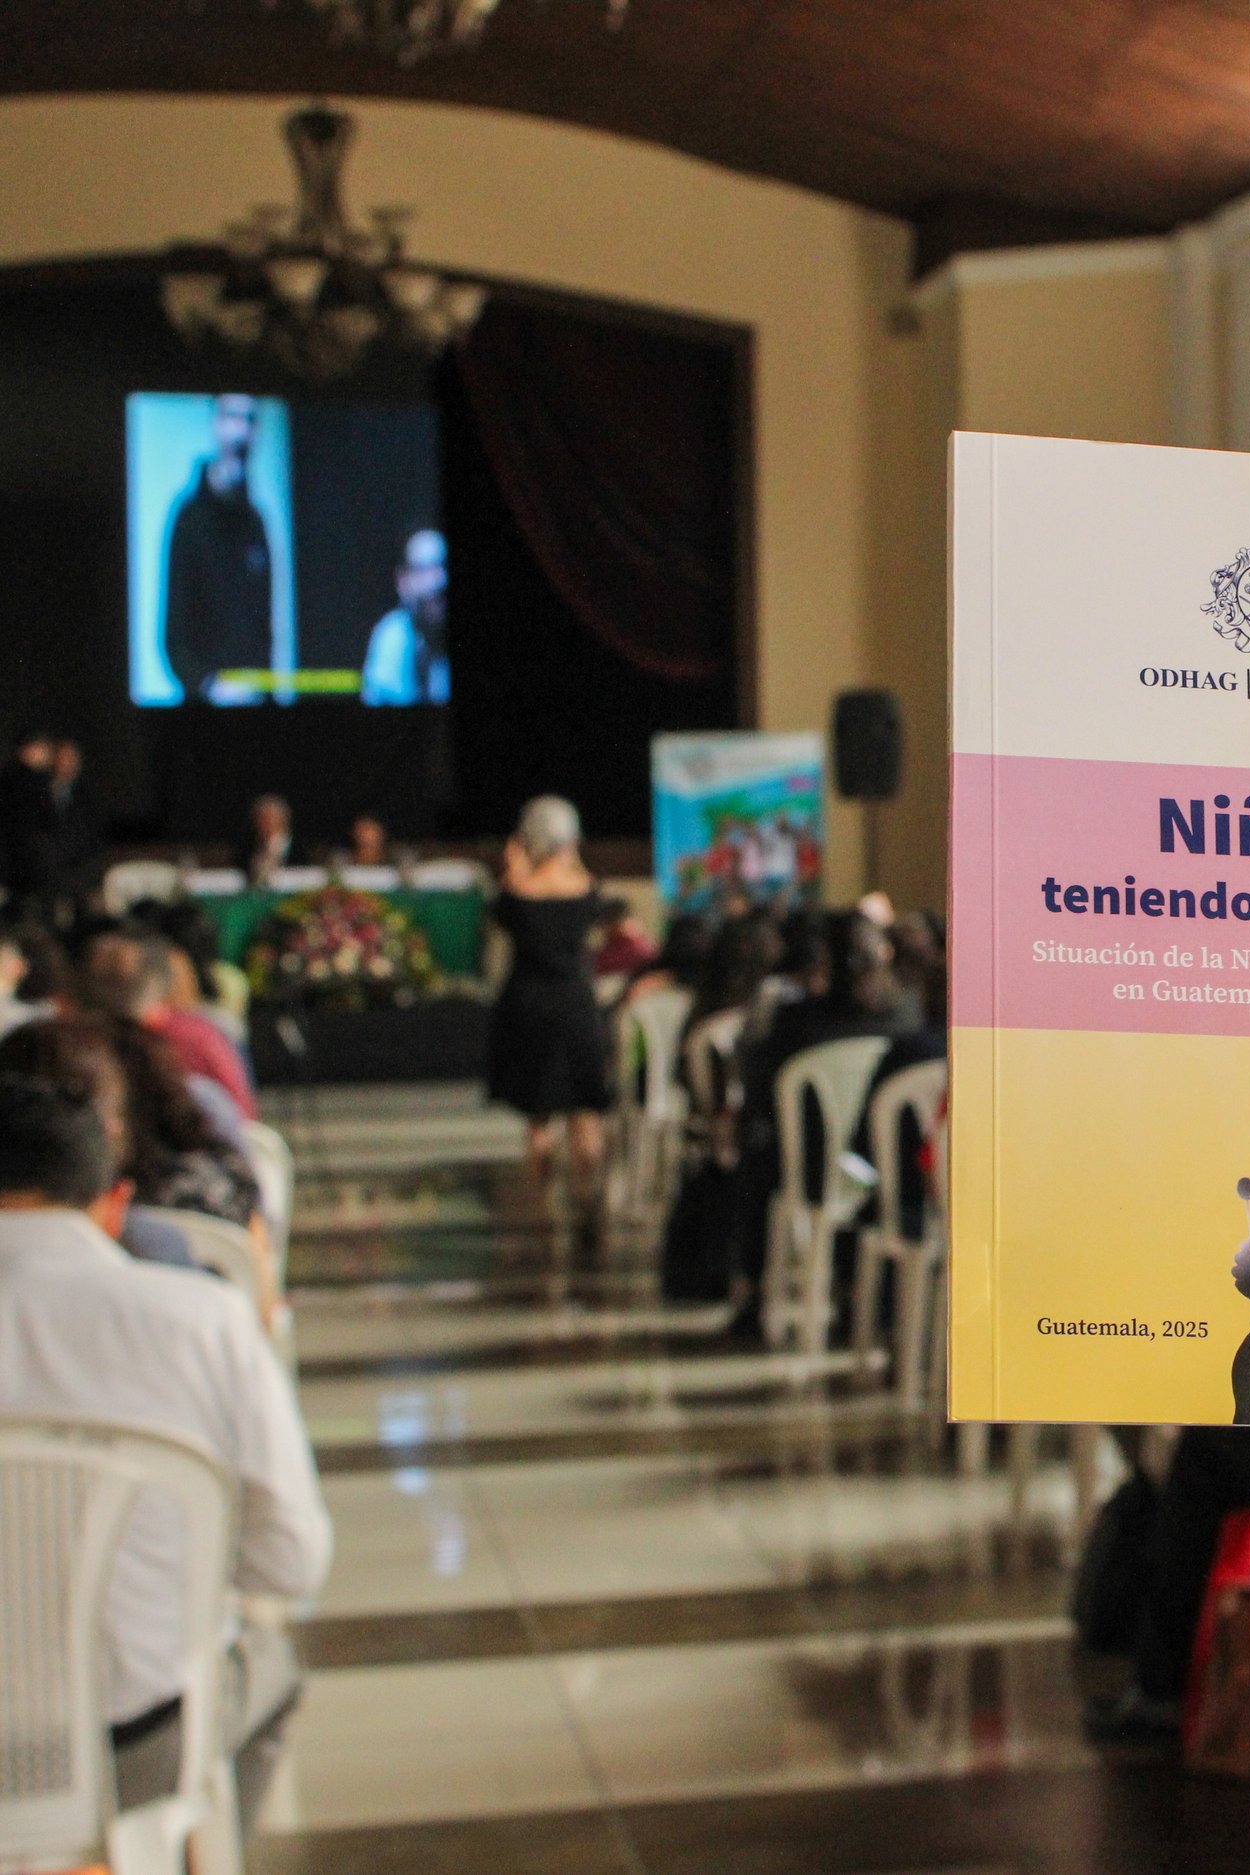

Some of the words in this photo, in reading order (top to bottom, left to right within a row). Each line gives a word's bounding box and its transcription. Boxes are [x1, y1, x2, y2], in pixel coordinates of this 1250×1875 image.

[1139, 667, 1238, 691] ODHAG
[1031, 940, 1156, 967] Situación
[1163, 946, 1194, 969] de
[1200, 946, 1224, 970] la
[1112, 984, 1145, 1001] en
[1037, 1317, 1156, 1341] Guatemala,
[1162, 1320, 1209, 1338] 2025
